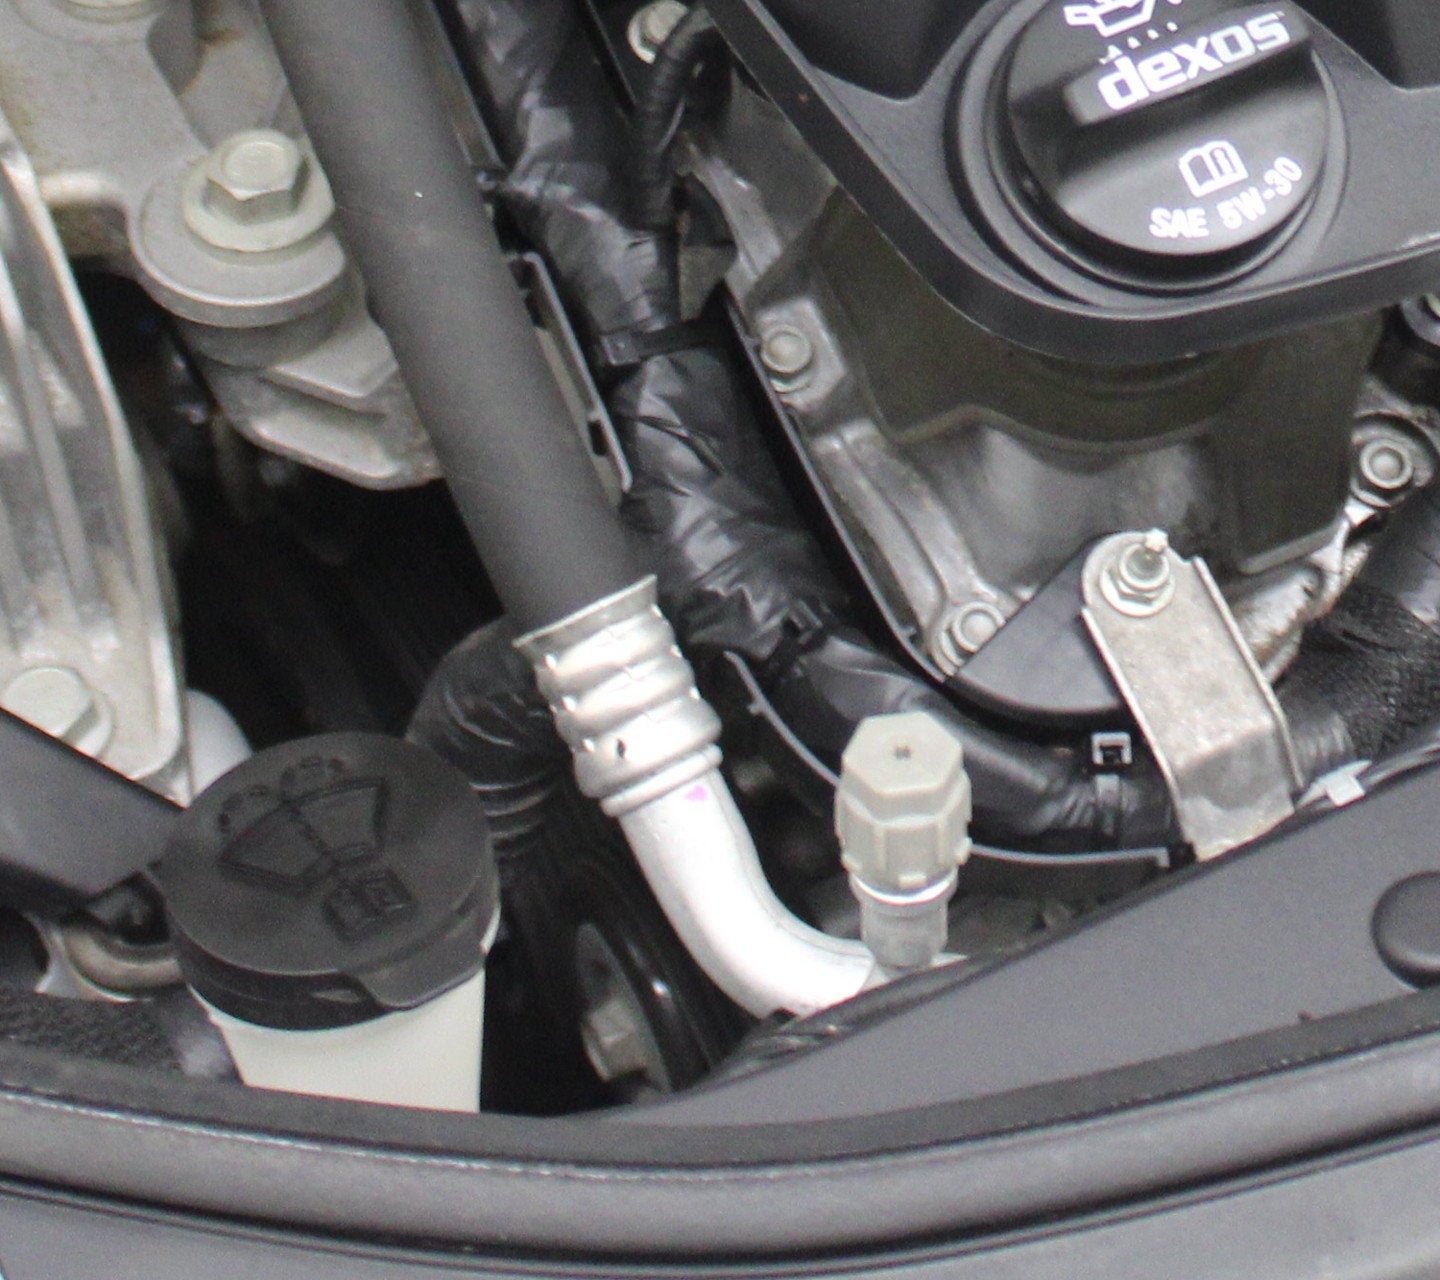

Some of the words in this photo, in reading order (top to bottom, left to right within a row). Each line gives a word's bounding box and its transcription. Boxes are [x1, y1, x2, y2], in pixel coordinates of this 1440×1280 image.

[1097, 12, 1290, 110] dexos
[1149, 206, 1209, 241] SAE
[1219, 157, 1303, 231] 5W-30
